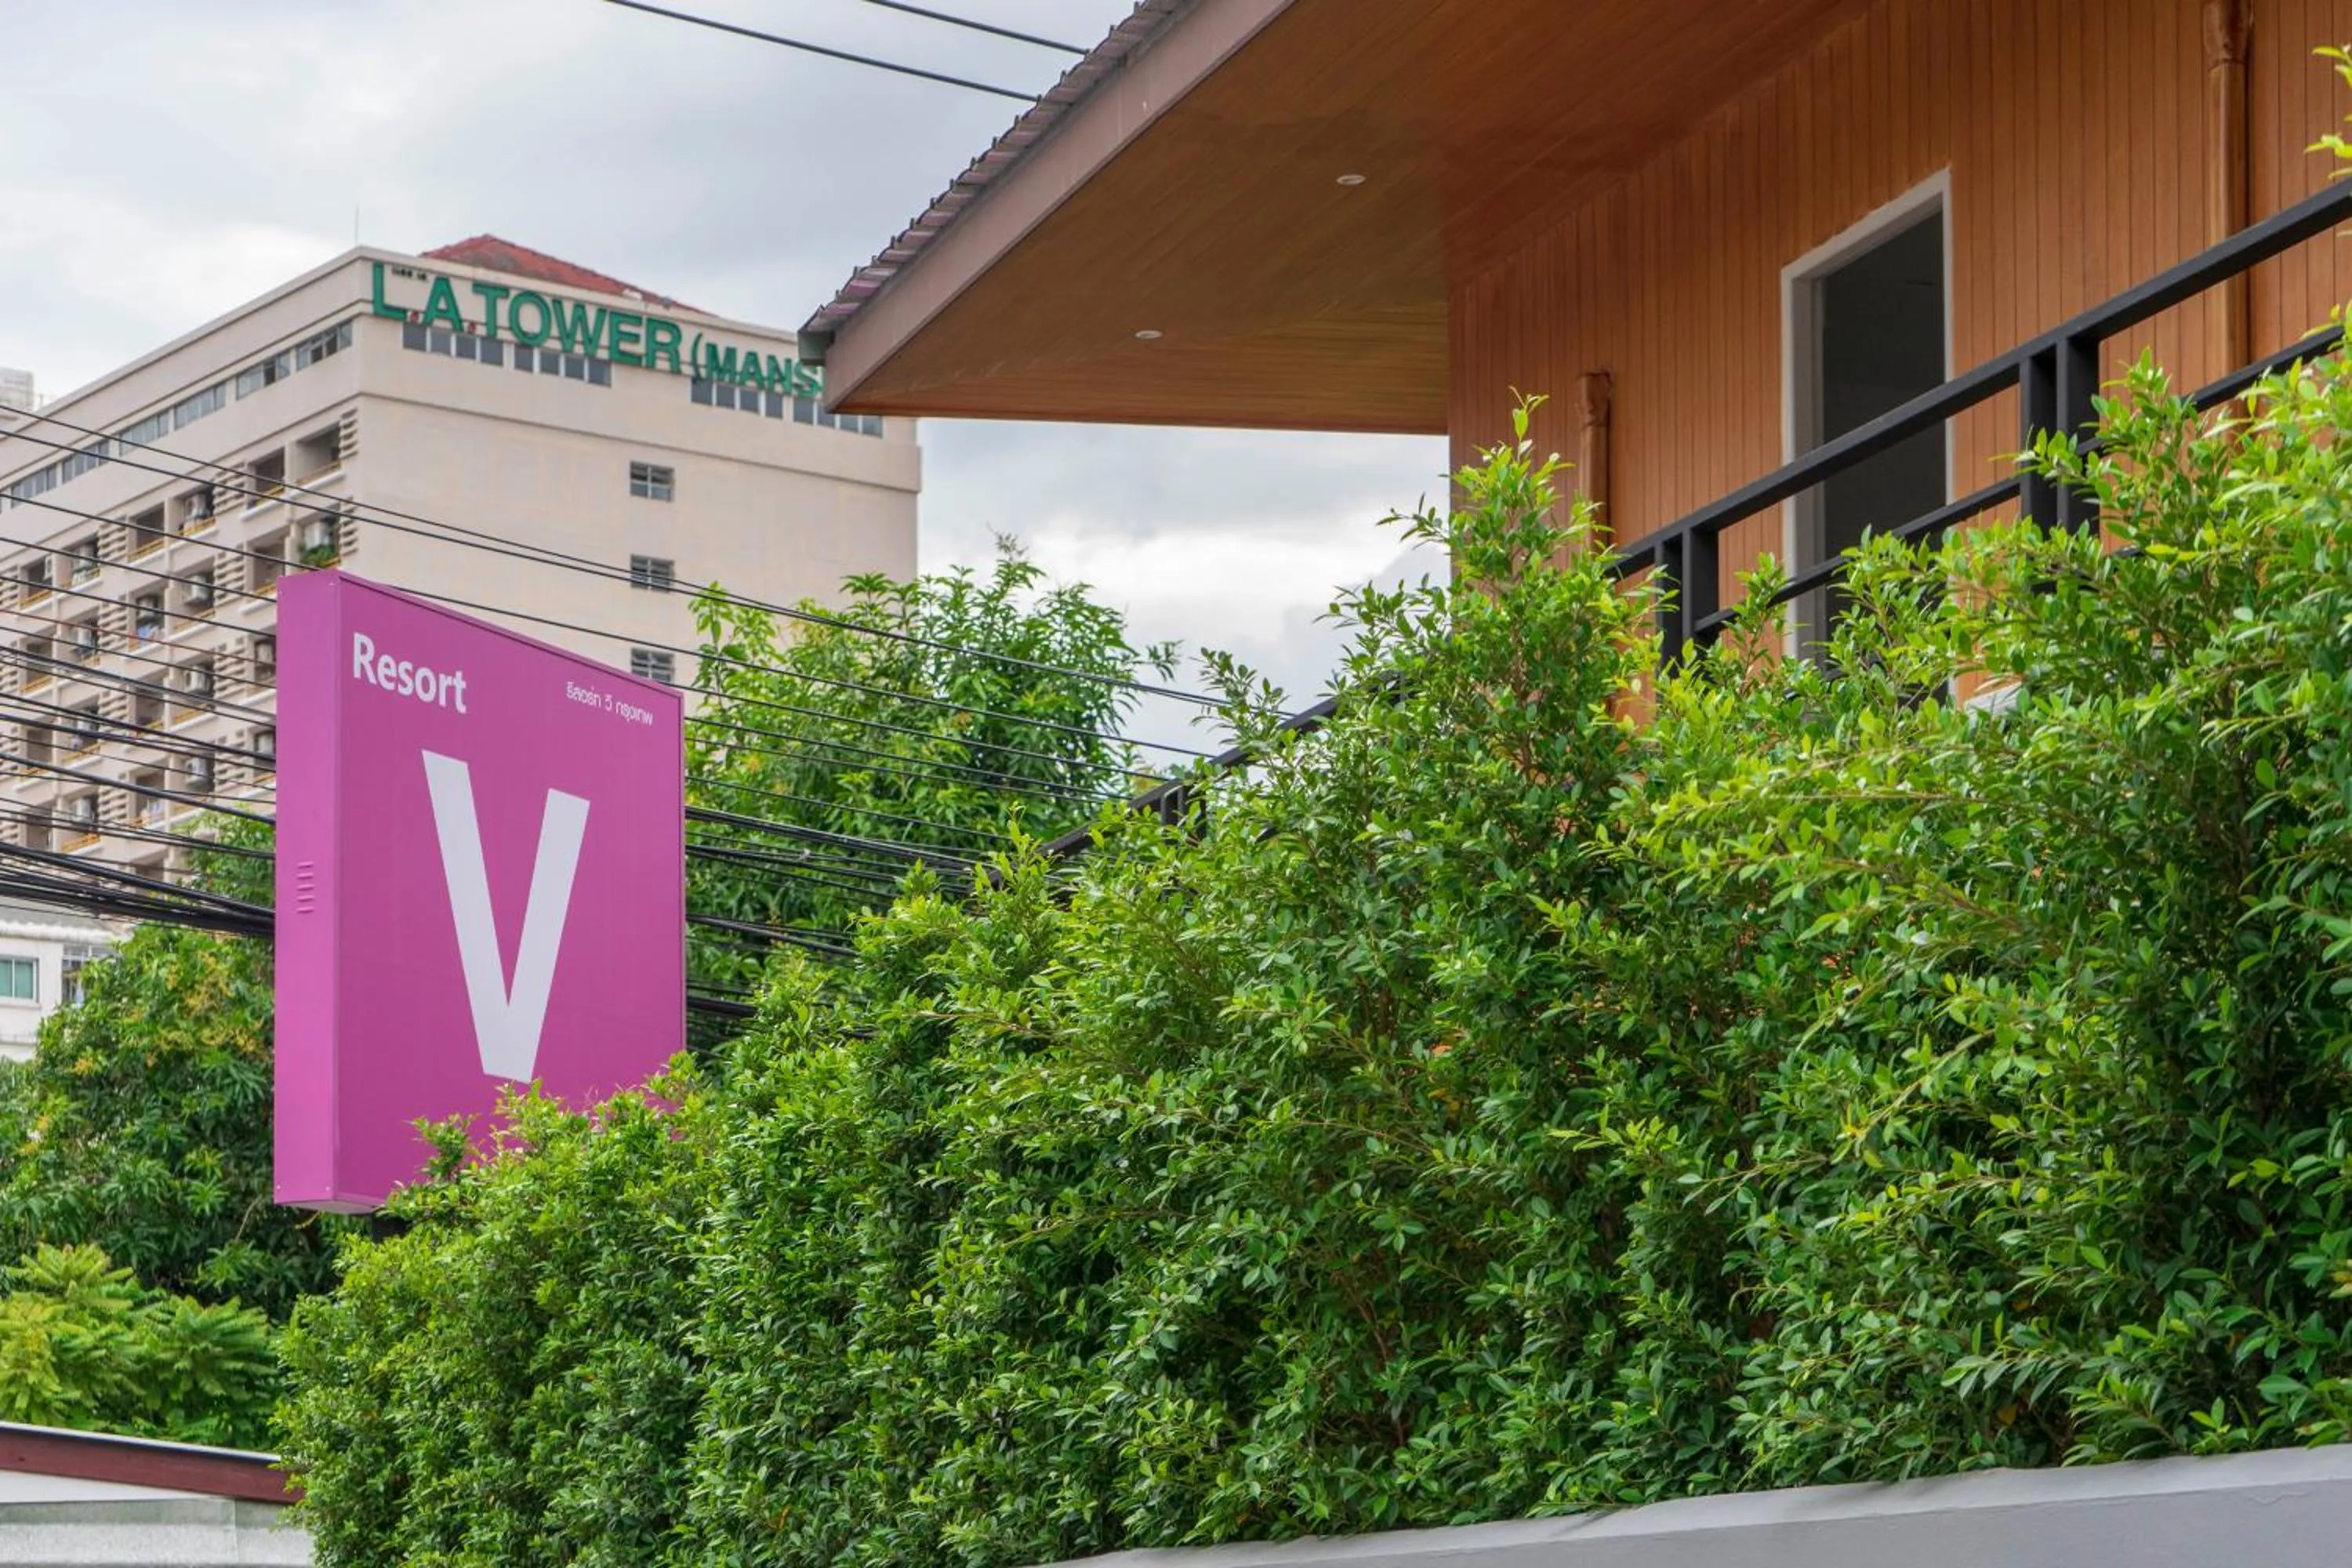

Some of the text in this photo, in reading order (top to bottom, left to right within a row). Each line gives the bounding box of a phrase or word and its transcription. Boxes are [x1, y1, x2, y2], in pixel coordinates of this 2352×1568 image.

[472, 281, 681, 374] TOWER
[691, 332, 824, 397] (MANS
[353, 632, 467, 714] Resort
[421, 750, 590, 1083] V
